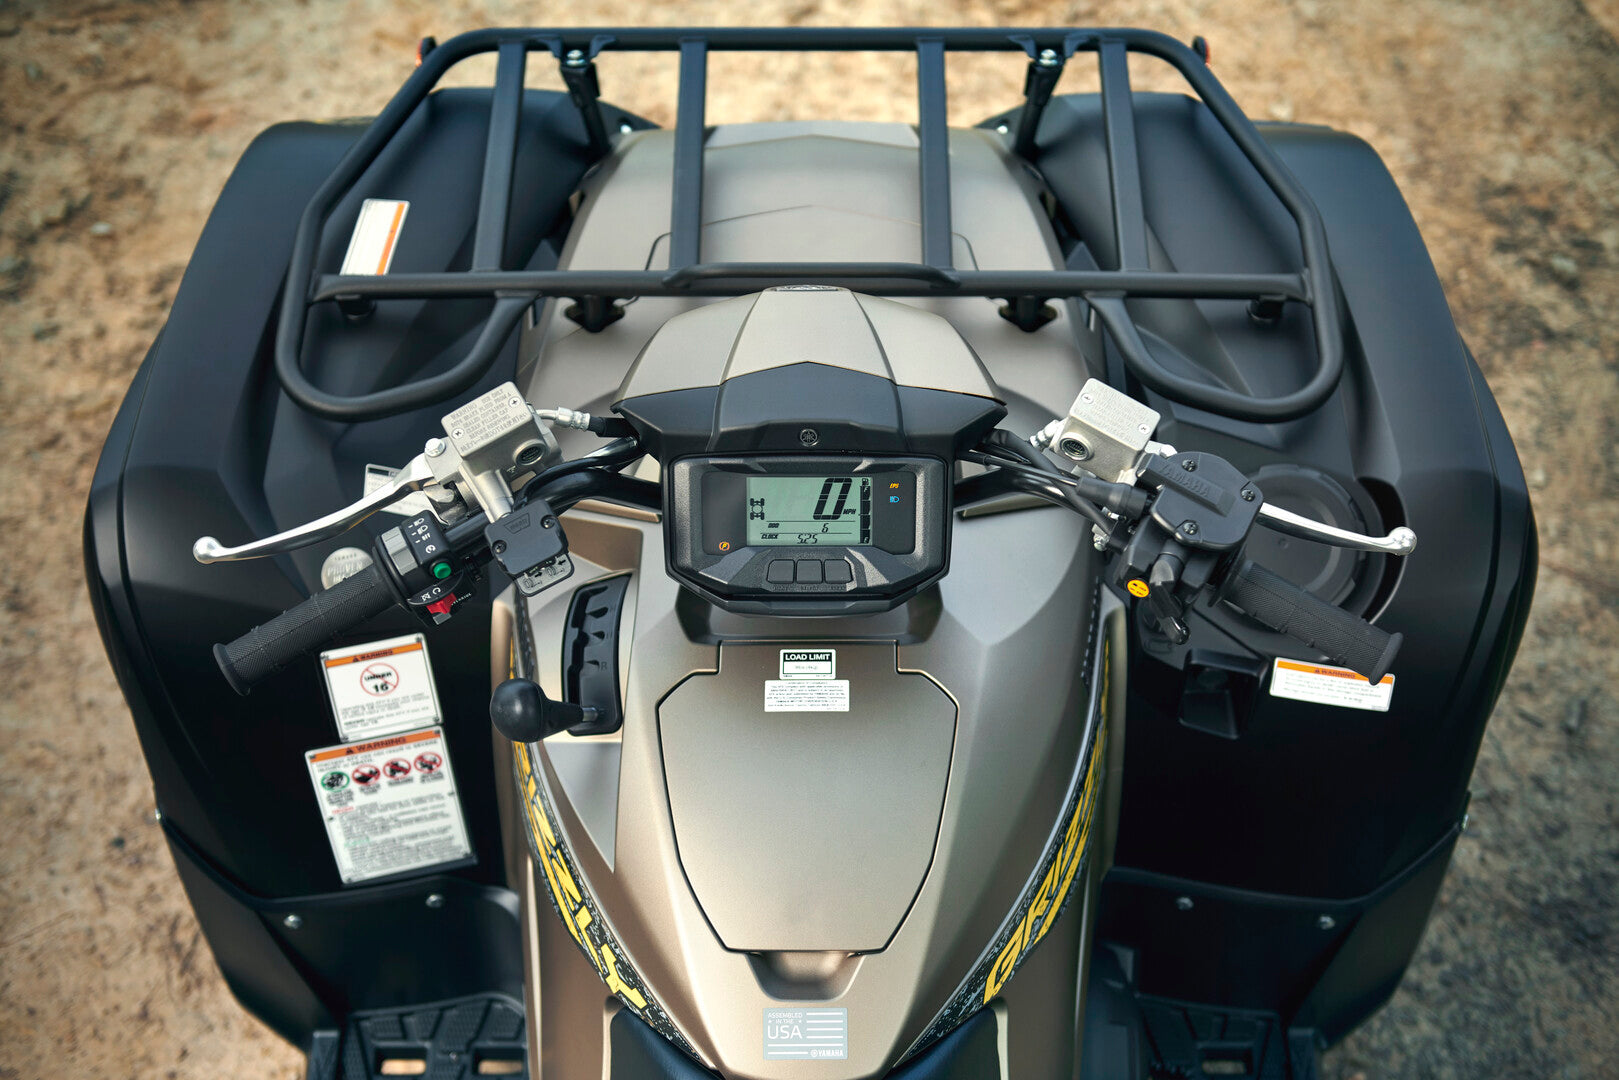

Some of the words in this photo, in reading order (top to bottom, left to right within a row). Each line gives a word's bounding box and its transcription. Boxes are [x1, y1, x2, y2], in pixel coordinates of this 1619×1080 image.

[812, 478, 852, 520] 0
[360, 650, 394, 660] WARNING
[1321, 668, 1356, 679] WARNING
[373, 683, 389, 693] 16
[356, 736, 407, 751] WARNING
[767, 1025, 803, 1039] USA
[818, 1049, 844, 1057] YAMAHA
